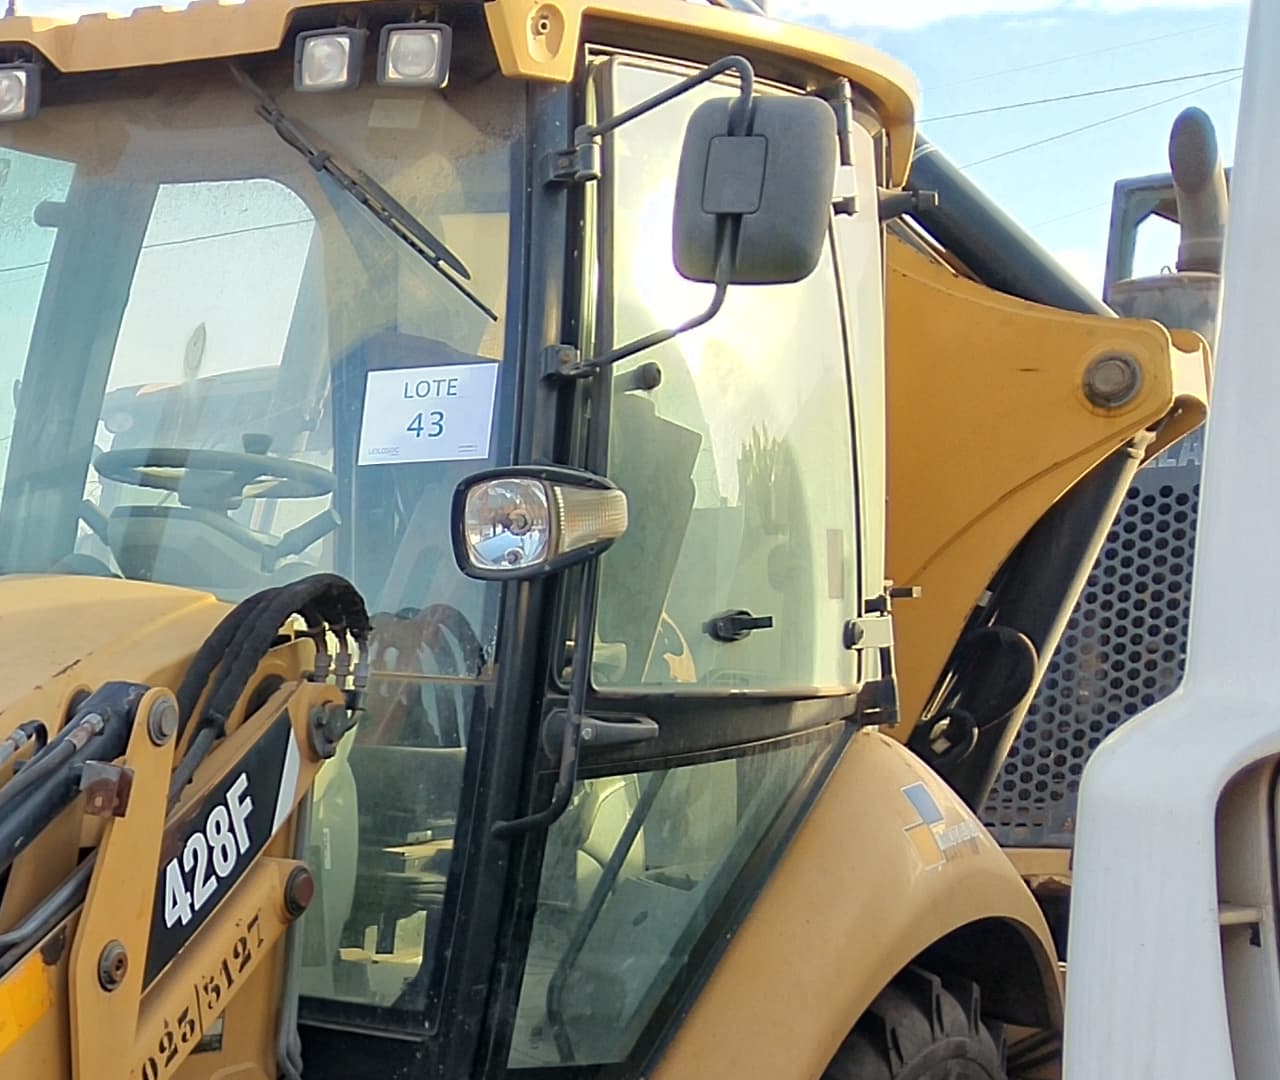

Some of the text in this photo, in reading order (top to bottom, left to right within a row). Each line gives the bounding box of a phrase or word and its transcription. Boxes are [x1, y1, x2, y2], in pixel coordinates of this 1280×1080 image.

[403, 378, 458, 399] LOTE
[406, 411, 445, 438] 43
[163, 772, 254, 929] 428F
